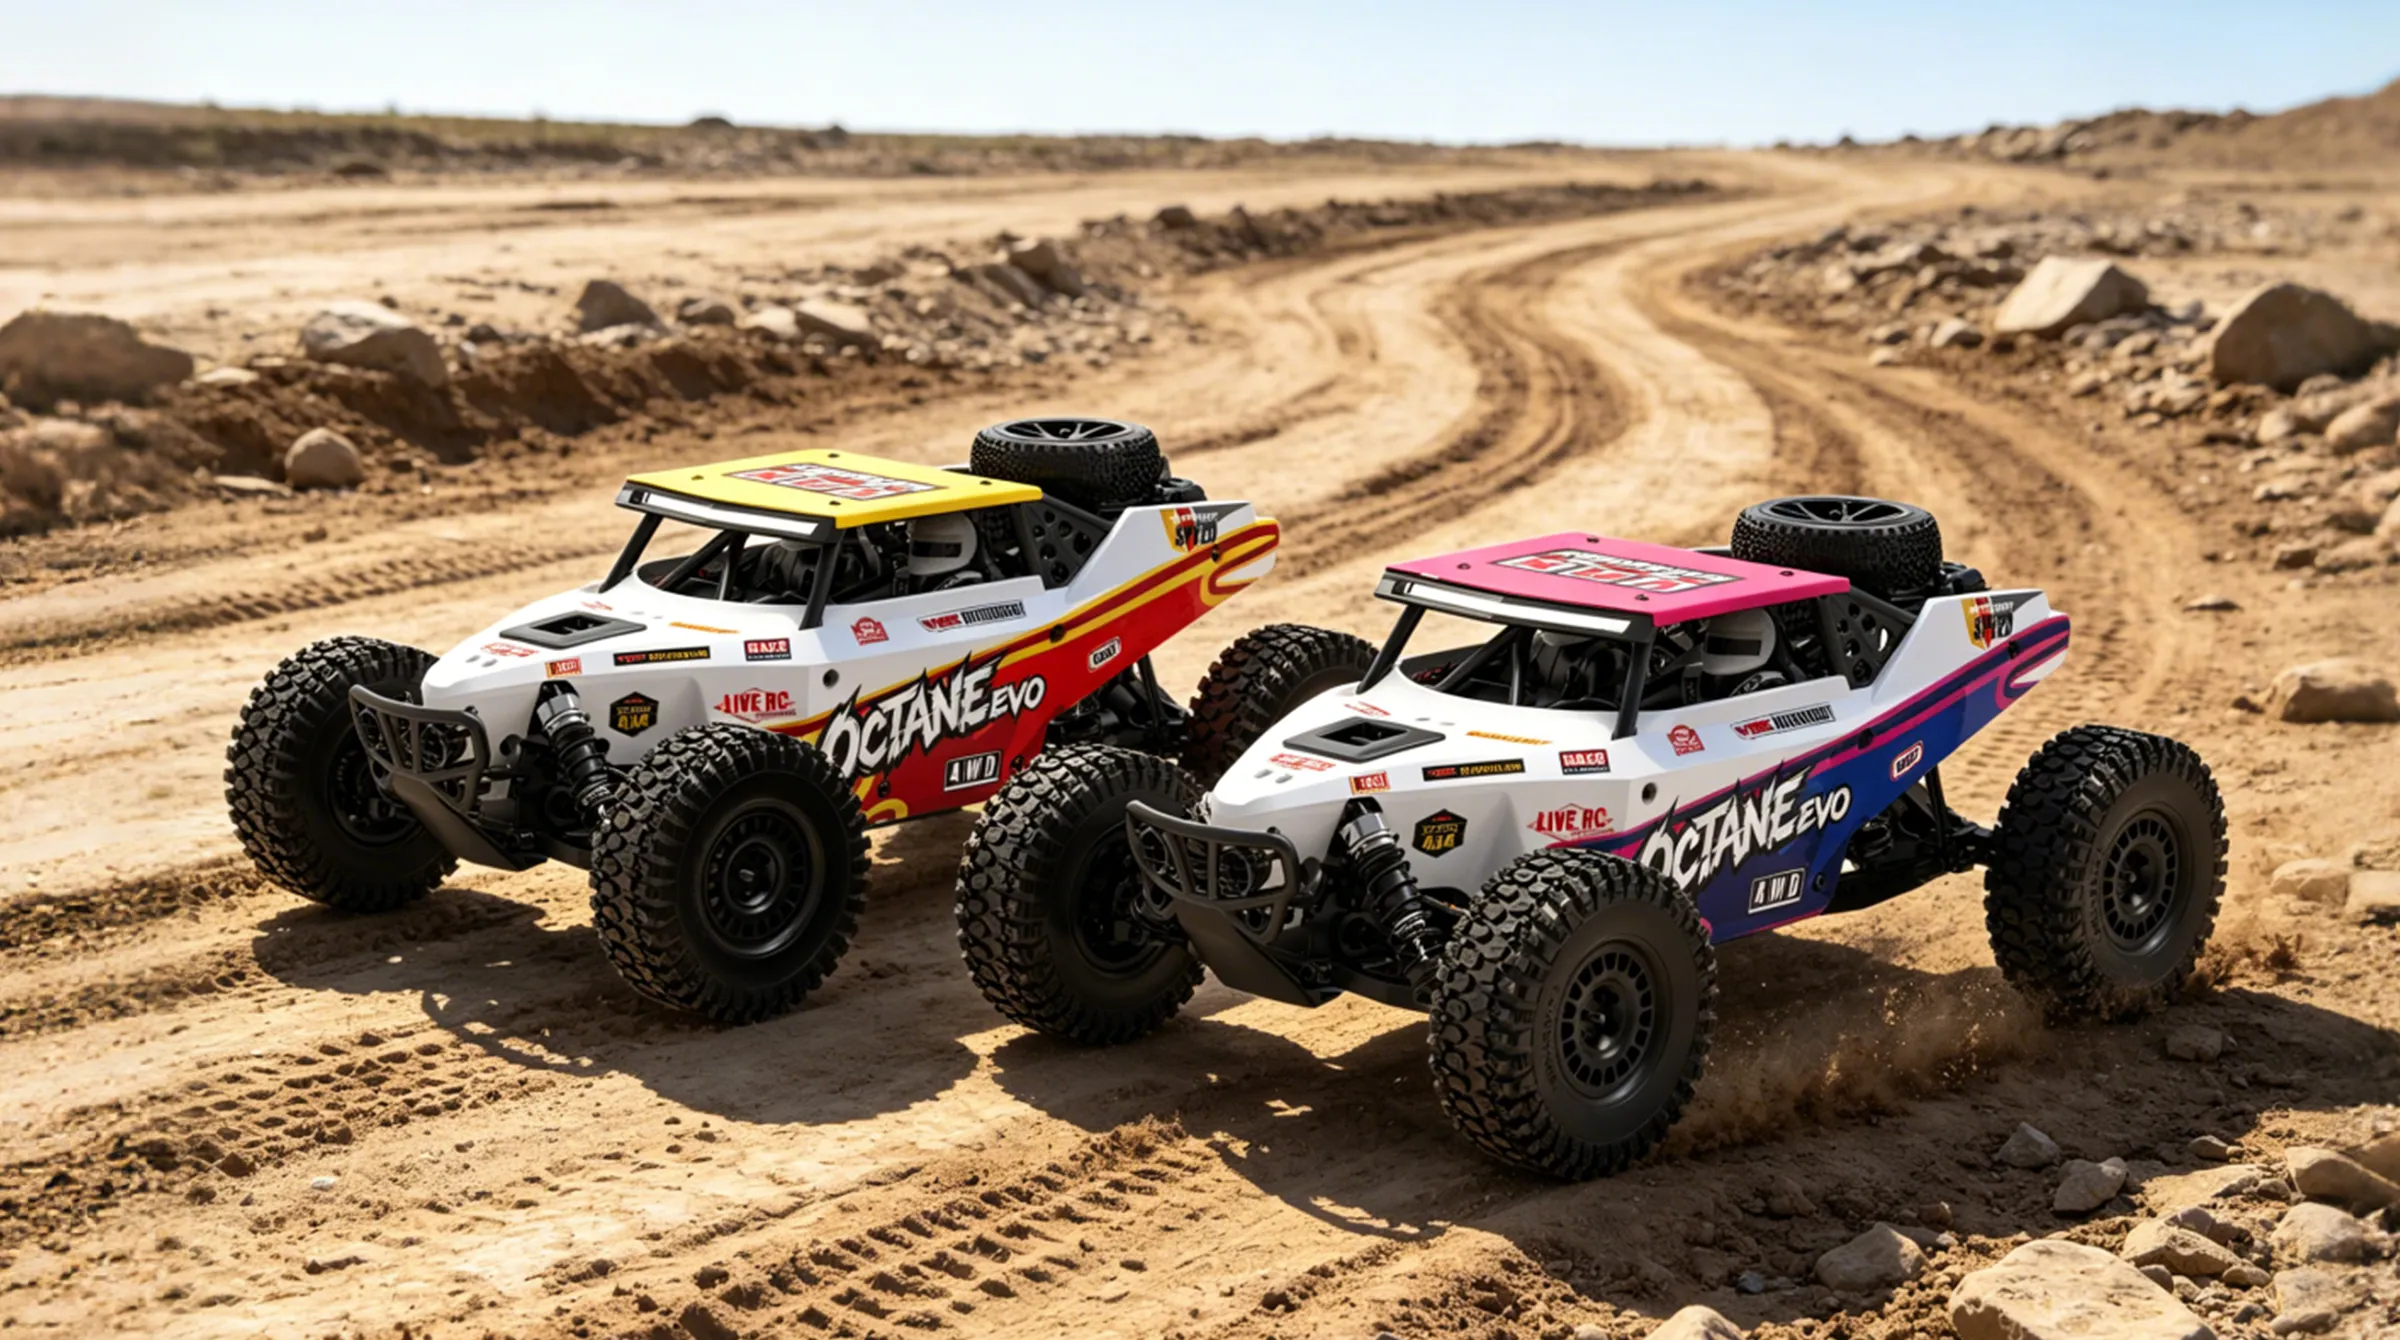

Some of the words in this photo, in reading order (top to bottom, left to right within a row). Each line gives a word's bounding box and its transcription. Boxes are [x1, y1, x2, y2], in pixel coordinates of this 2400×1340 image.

[765, 690, 790, 712] RC
[820, 654, 1004, 779] OCTANE
[989, 676, 1046, 719] EVO
[1535, 810, 1578, 832] LIVE
[1582, 807, 1608, 829] RC
[1639, 764, 1812, 890] OCTANE
[1796, 785, 1851, 834] EVO
